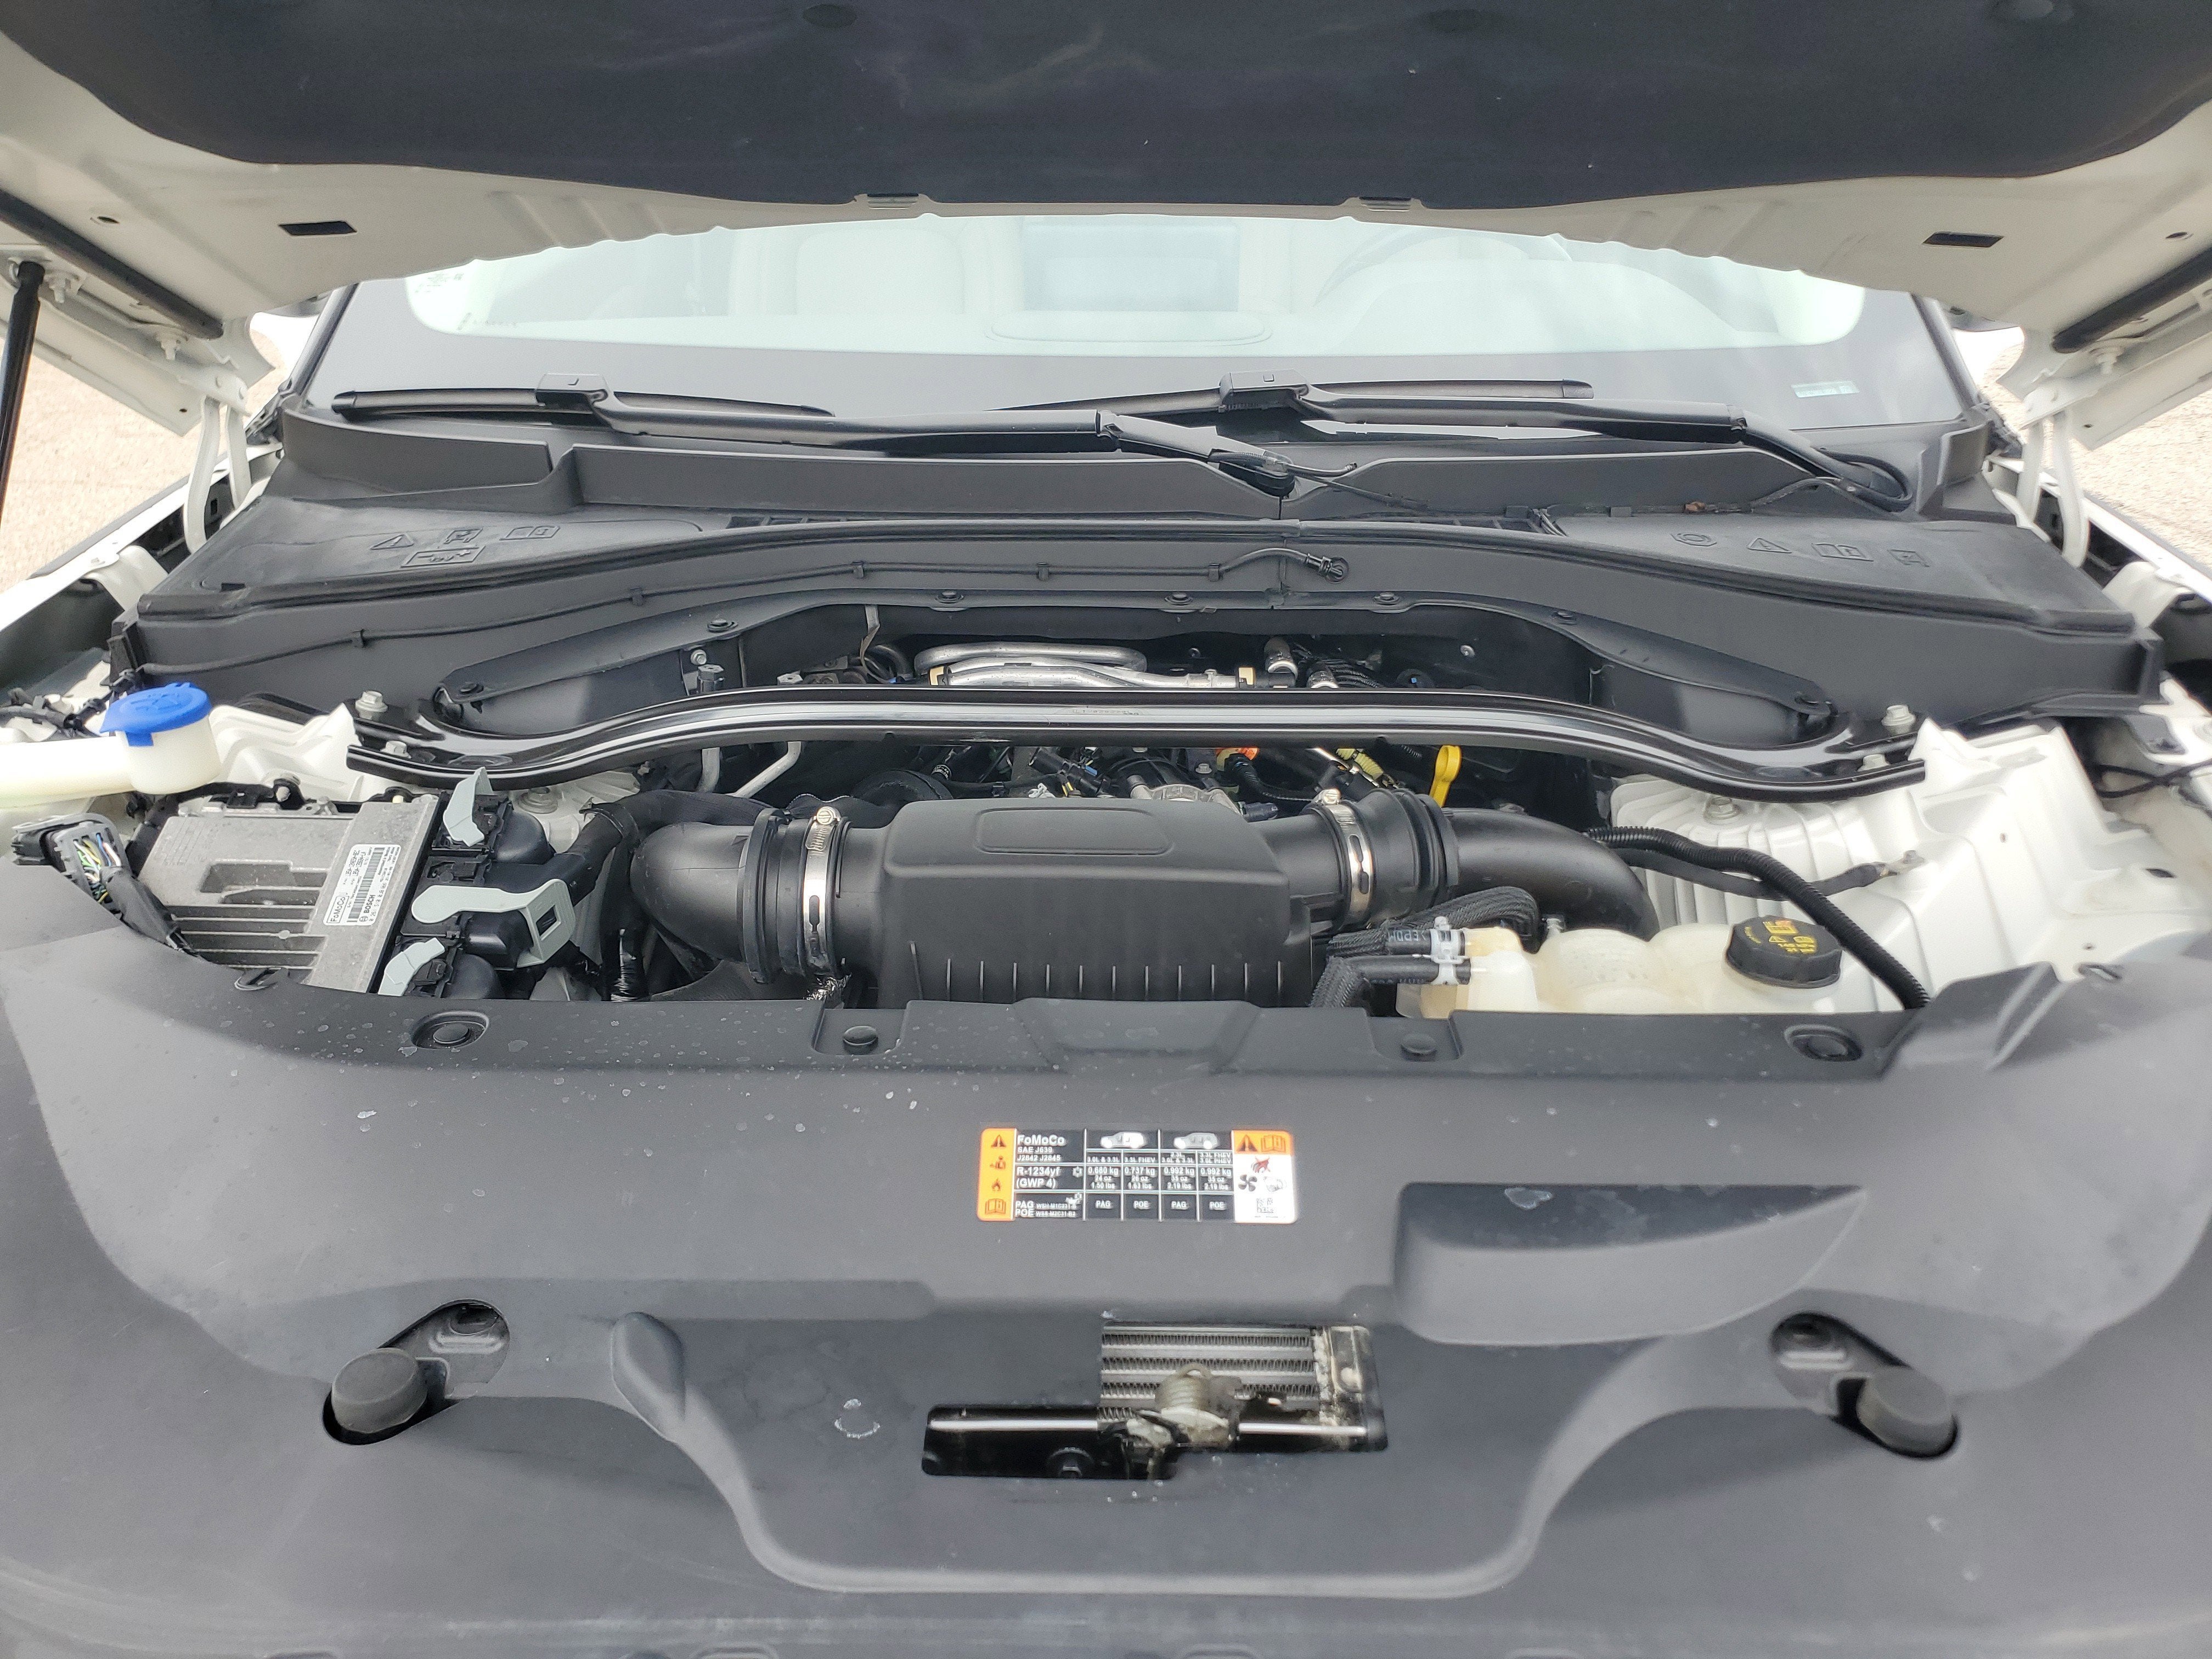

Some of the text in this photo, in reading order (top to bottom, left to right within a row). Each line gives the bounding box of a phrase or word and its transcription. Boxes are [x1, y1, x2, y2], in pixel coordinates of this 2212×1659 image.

[364, 894, 375, 914] BOSCH
[330, 897, 346, 922] FoMoCo
[1018, 1134, 1066, 1146] FoMoCo
[1017, 1166, 1060, 1178] R-1234yf
[1088, 1166, 1120, 1177] 0.680 kg
[1124, 1166, 1156, 1177] 0.737 kg
[1185, 1167, 1195, 1177] kg
[1222, 1167, 1232, 1177] kg
[1016, 1178, 1057, 1189] (GWP 4)
[1015, 1200, 1034, 1209] PAG
[1096, 1200, 1112, 1209] PAG
[1133, 1200, 1150, 1209] POE
[1171, 1201, 1187, 1209] PAG
[1209, 1201, 1226, 1210] POE
[1015, 1209, 1035, 1217] POE
